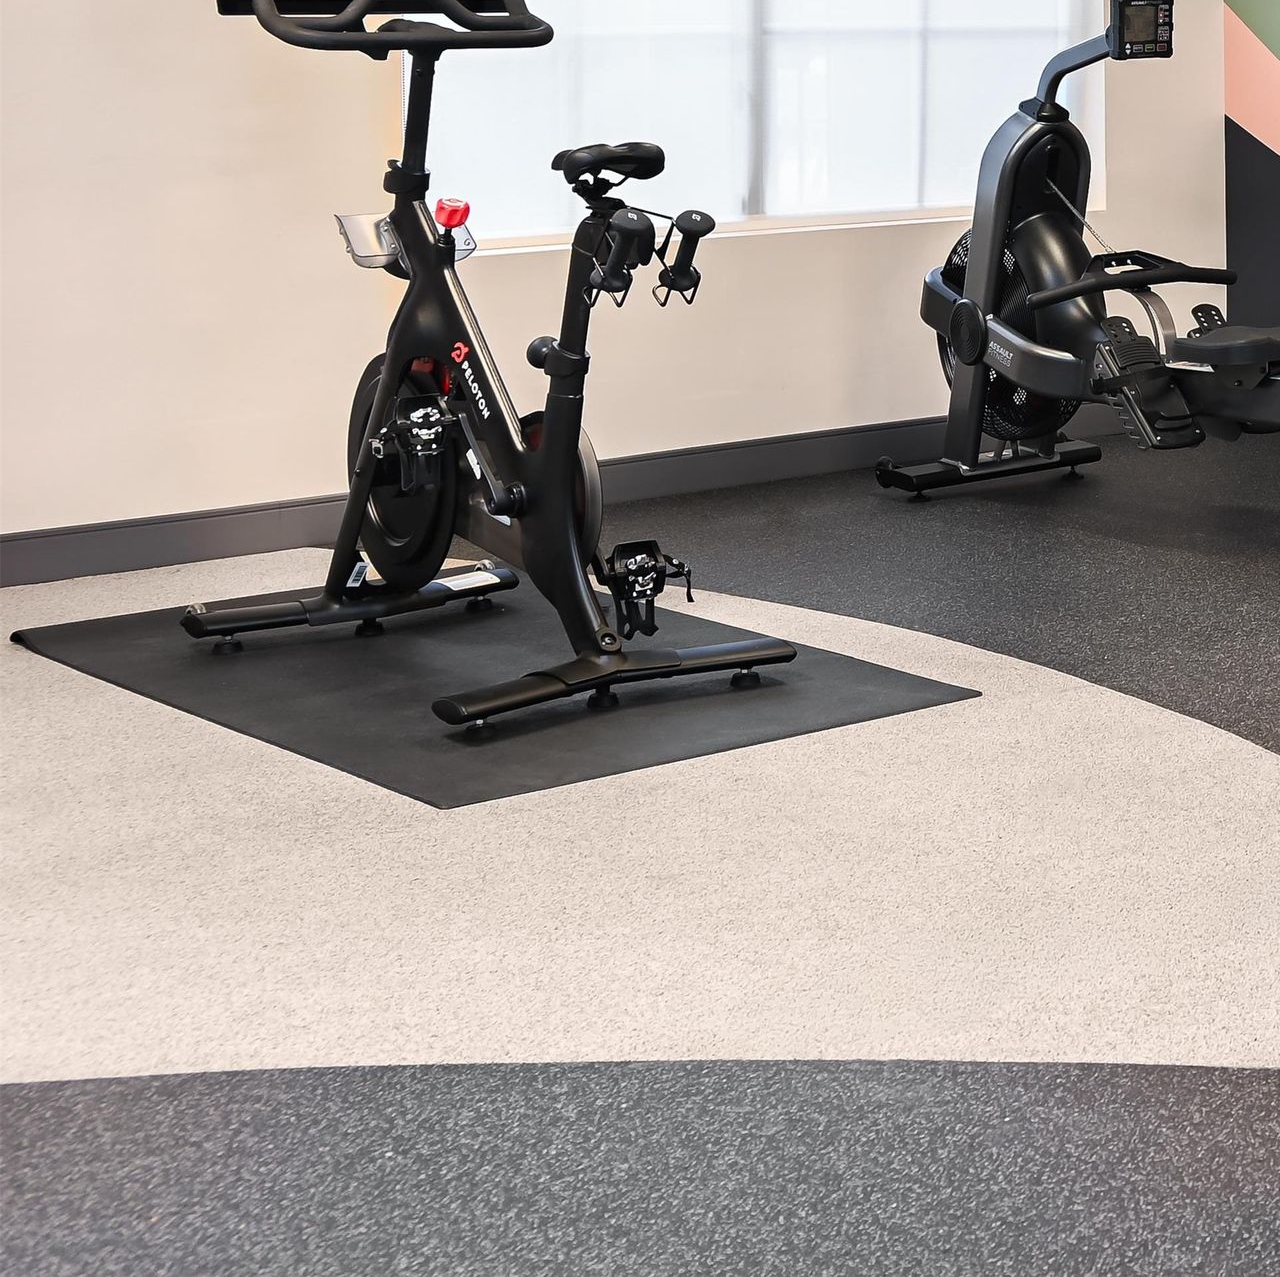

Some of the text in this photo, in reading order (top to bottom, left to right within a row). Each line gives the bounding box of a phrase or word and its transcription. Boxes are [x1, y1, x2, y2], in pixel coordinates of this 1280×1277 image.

[987, 348, 1012, 367] FITNESS
[988, 341, 1014, 359] ASSAULT
[461, 360, 491, 420] PELOTON
